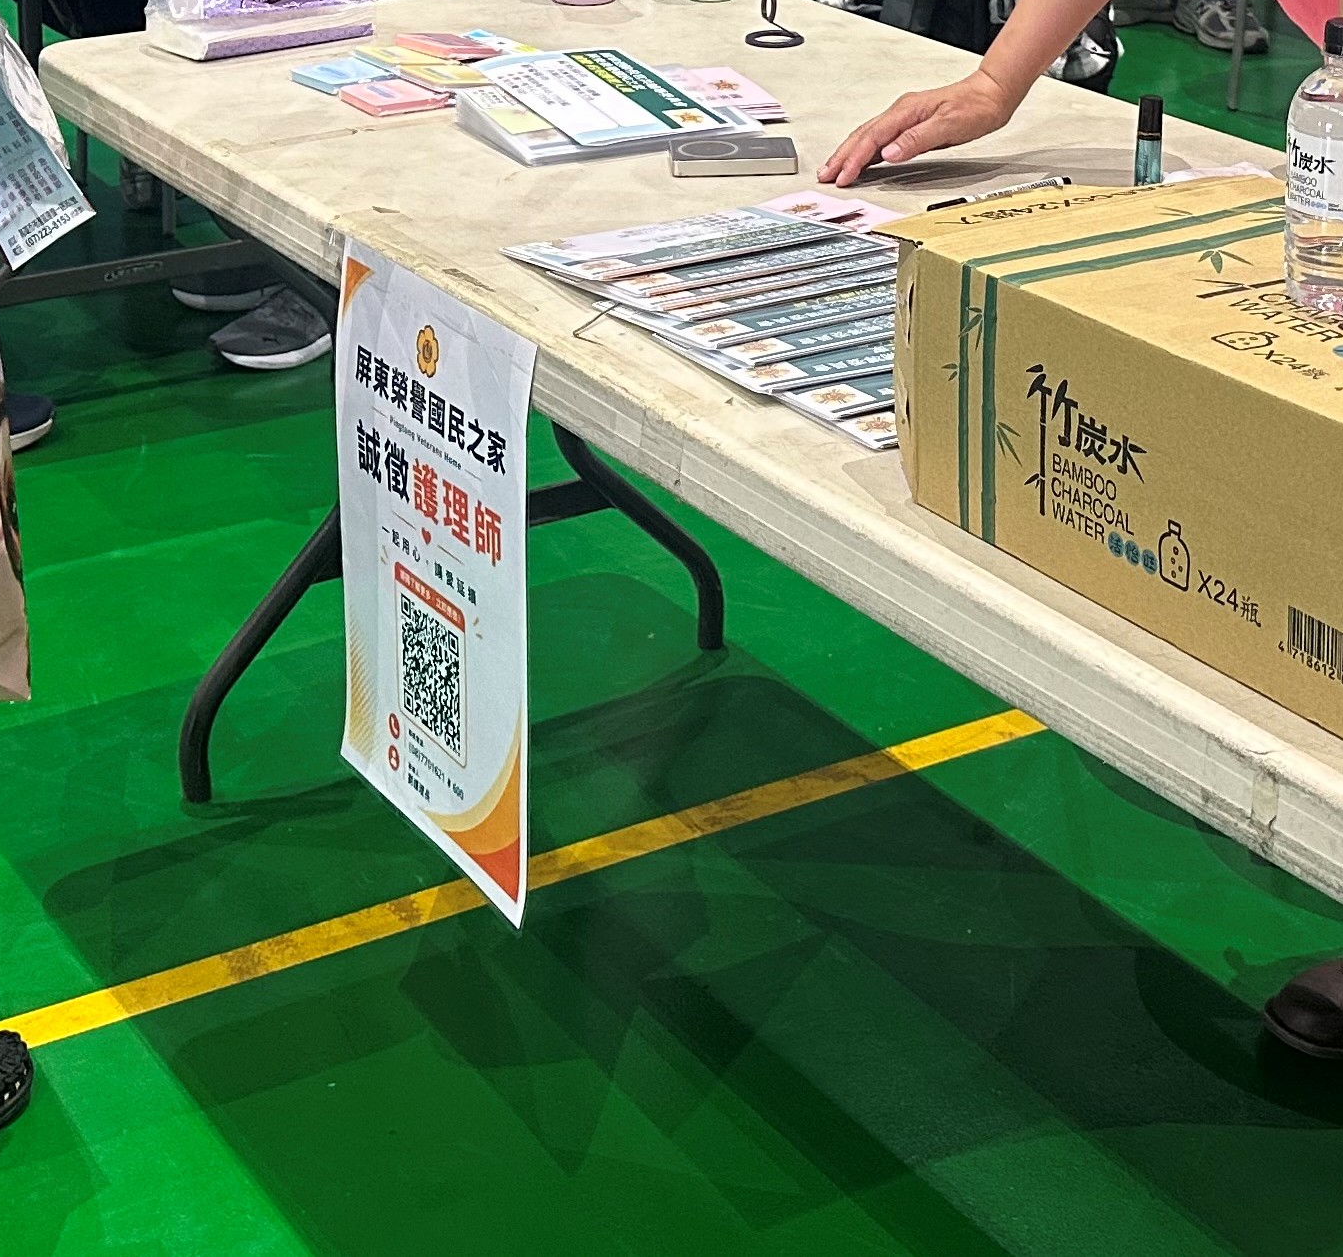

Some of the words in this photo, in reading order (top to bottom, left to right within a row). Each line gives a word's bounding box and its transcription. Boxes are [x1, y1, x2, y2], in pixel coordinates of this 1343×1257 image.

[1229, 298, 1343, 343] WATER
[355, 344, 507, 476] 屏東榮譽國民之家
[1026, 364, 1148, 484] 竹炭水
[1051, 455, 1117, 501] BAMBOO
[1051, 477, 1134, 536] CHARCOAL
[1051, 499, 1106, 542] WATER
[1197, 569, 1262, 627] X24瓶
[1292, 647, 1336, 680] 718612
